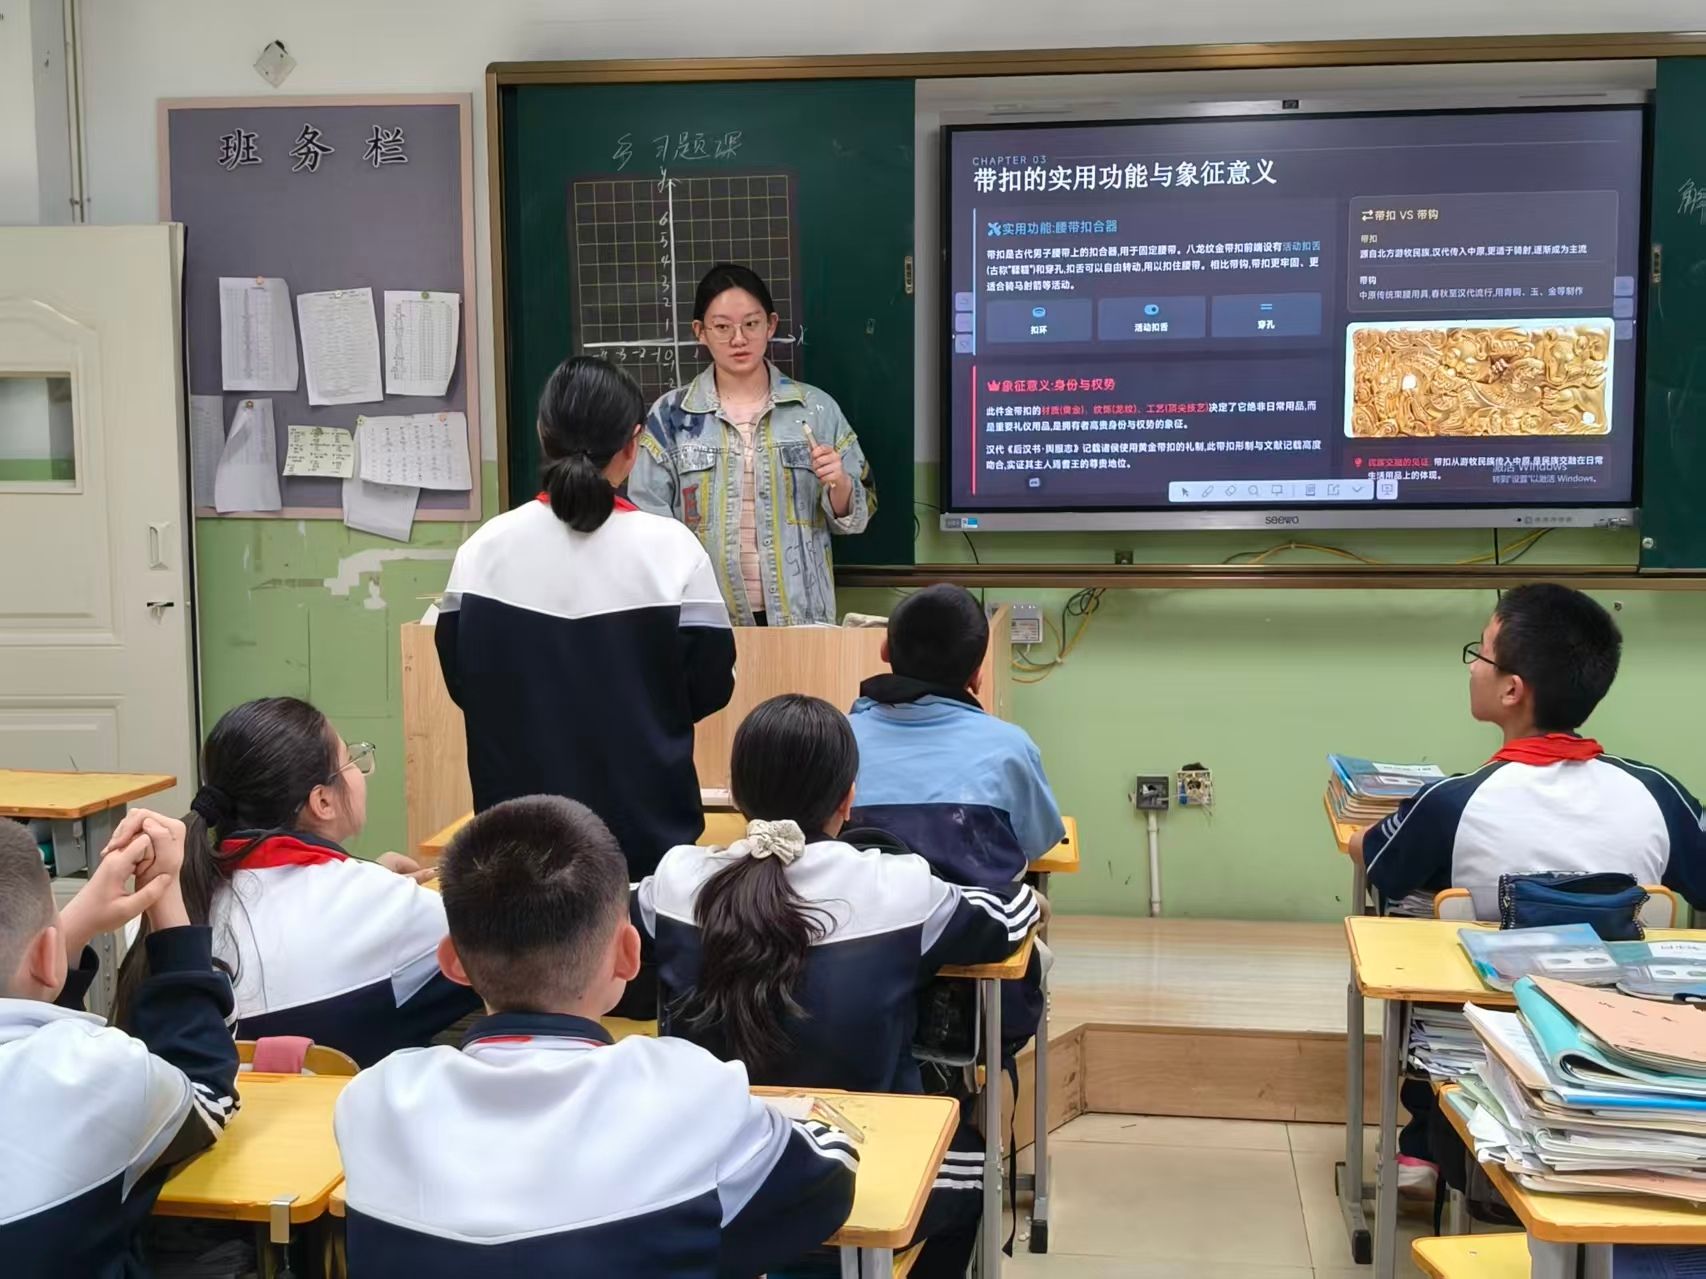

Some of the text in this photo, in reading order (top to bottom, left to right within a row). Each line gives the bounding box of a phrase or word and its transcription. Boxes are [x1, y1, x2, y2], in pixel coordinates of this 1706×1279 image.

[217, 123, 409, 172] 班务栏
[972, 154, 1047, 166] CHAPTER 03
[974, 158, 1277, 193] 带扣的实用功能与象征意义
[1374, 209, 1439, 221] 带扣 VS 带钩
[1360, 234, 1378, 243] 带扣
[1030, 325, 1048, 335] 扣环
[1257, 319, 1276, 331] 穿孔
[1265, 515, 1299, 525] seewo
